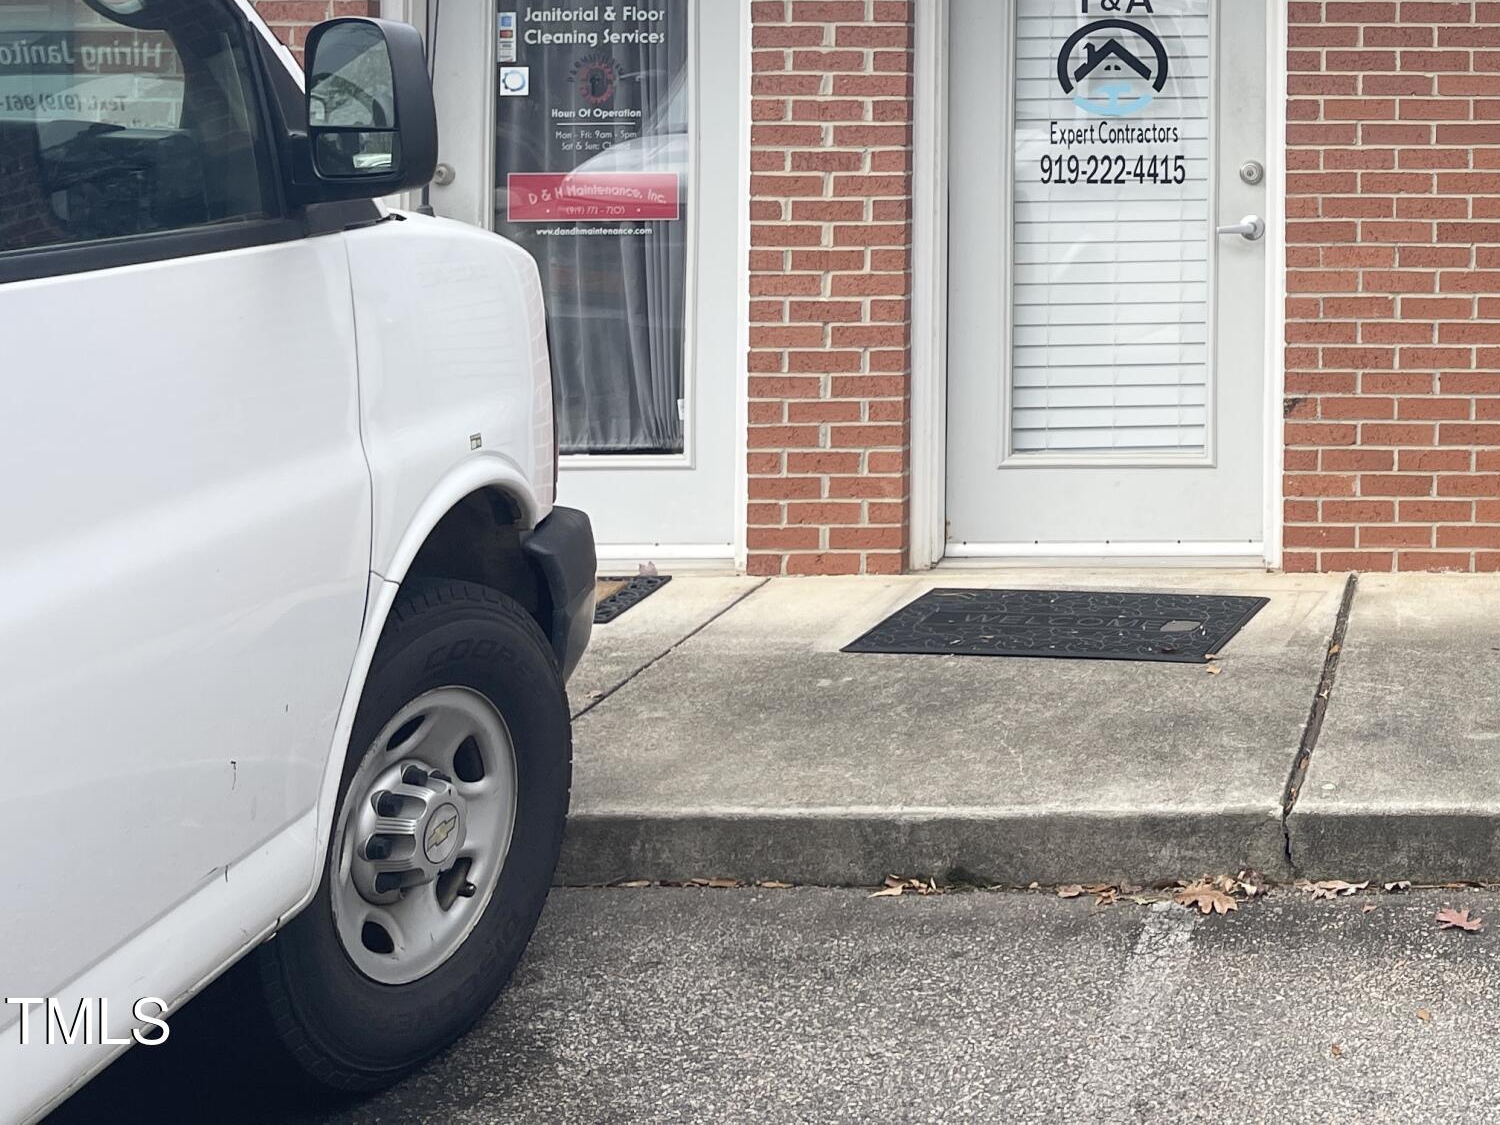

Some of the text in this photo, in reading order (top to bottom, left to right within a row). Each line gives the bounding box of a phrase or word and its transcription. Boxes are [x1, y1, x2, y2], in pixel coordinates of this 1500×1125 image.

[524, 7, 665, 22] Janitorial & Floor
[524, 28, 665, 47] Cleaning Services
[551, 108, 642, 120] Hours Of Operation
[1050, 121, 1178, 150] Expert Contractors
[1040, 154, 1186, 185] 919-222-4415
[528, 184, 667, 205] D & H Maintenance, Inc.
[536, 227, 653, 236] www.dandhmaintenance.com
